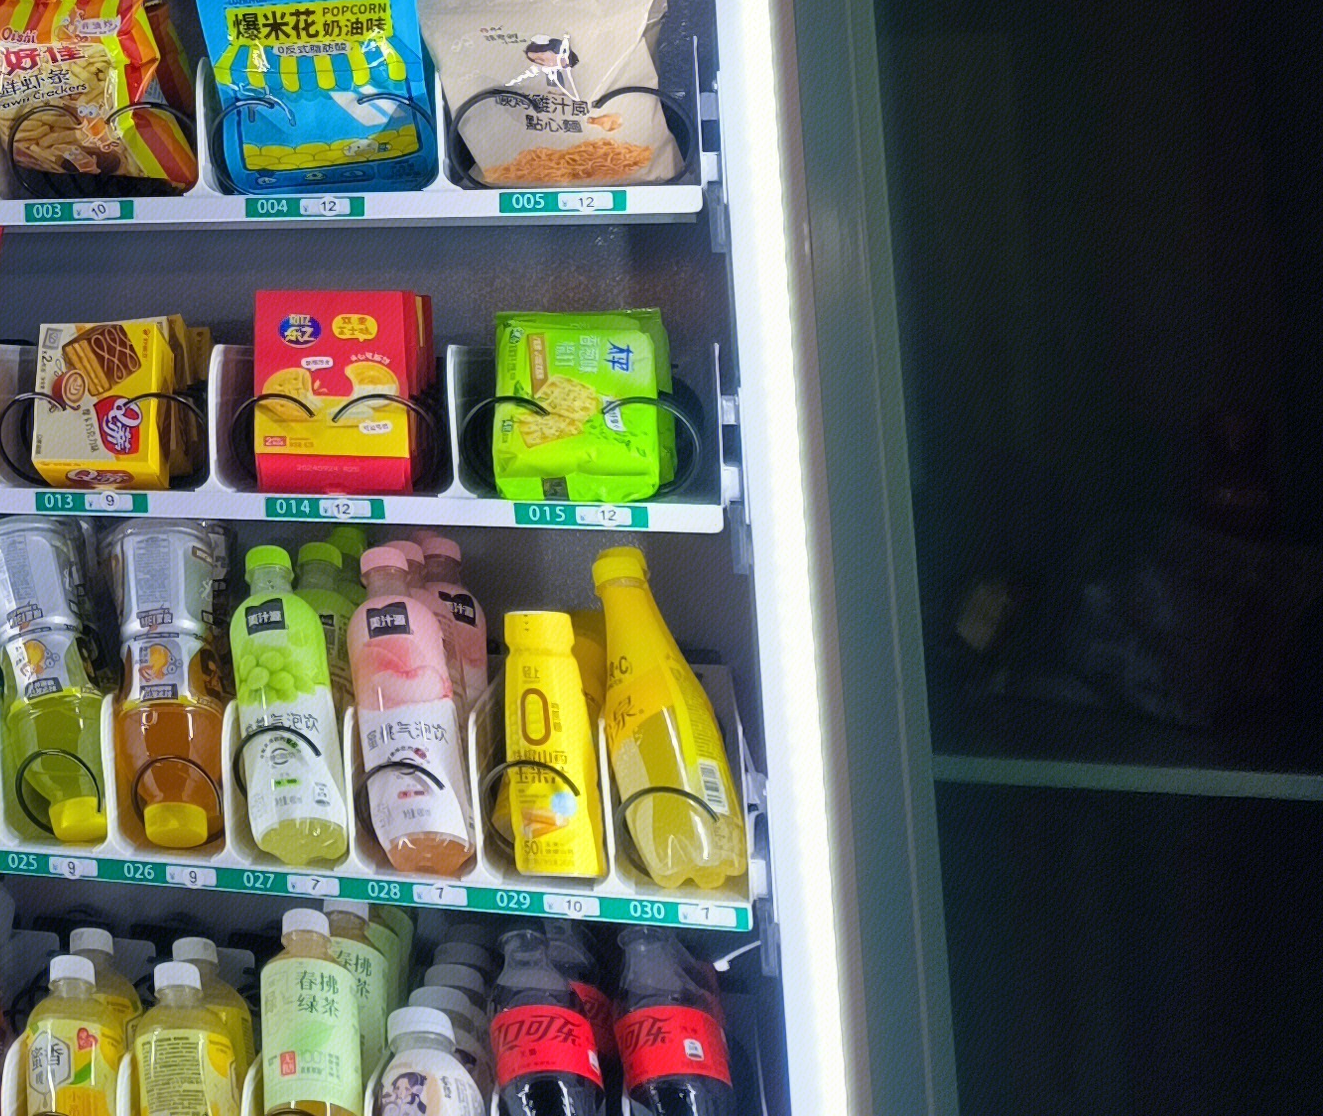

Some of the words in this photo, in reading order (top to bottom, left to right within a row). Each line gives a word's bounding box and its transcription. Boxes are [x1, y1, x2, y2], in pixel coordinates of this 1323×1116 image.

[322, 2, 387, 17] POPCORN
[232, 7, 319, 41] 爆米花
[322, 16, 386, 36] 奶油味
[1, 26, 38, 44] Oishi
[33, 83, 87, 101] Crackers
[257, 200, 288, 214] 004
[321, 200, 337, 212] 12
[512, 193, 545, 209] 005
[578, 197, 595, 208] 12
[33, 204, 62, 218] 003
[91, 204, 106, 217] 10
[288, 314, 312, 326] RITZ
[284, 325, 318, 342] 乐之
[605, 338, 634, 373] 太平
[44, 494, 74, 508] 013
[105, 495, 115, 506] 9
[276, 499, 311, 514] 014
[335, 503, 351, 515] 12
[528, 506, 566, 521] 015
[599, 510, 617, 521] 12
[8, 854, 38, 869] 025
[66, 860, 76, 873] 9
[123, 862, 154, 878] 026
[188, 869, 198, 883] 9
[243, 872, 275, 889] 027
[311, 878, 321, 891] 7
[367, 882, 401, 900] 028
[435, 886, 445, 900] 7
[496, 891, 530, 909] 029
[564, 899, 583, 913] 10
[629, 901, 665, 919] 030
[700, 906, 711, 920] 7
[296, 995, 340, 1019] 绿茶
